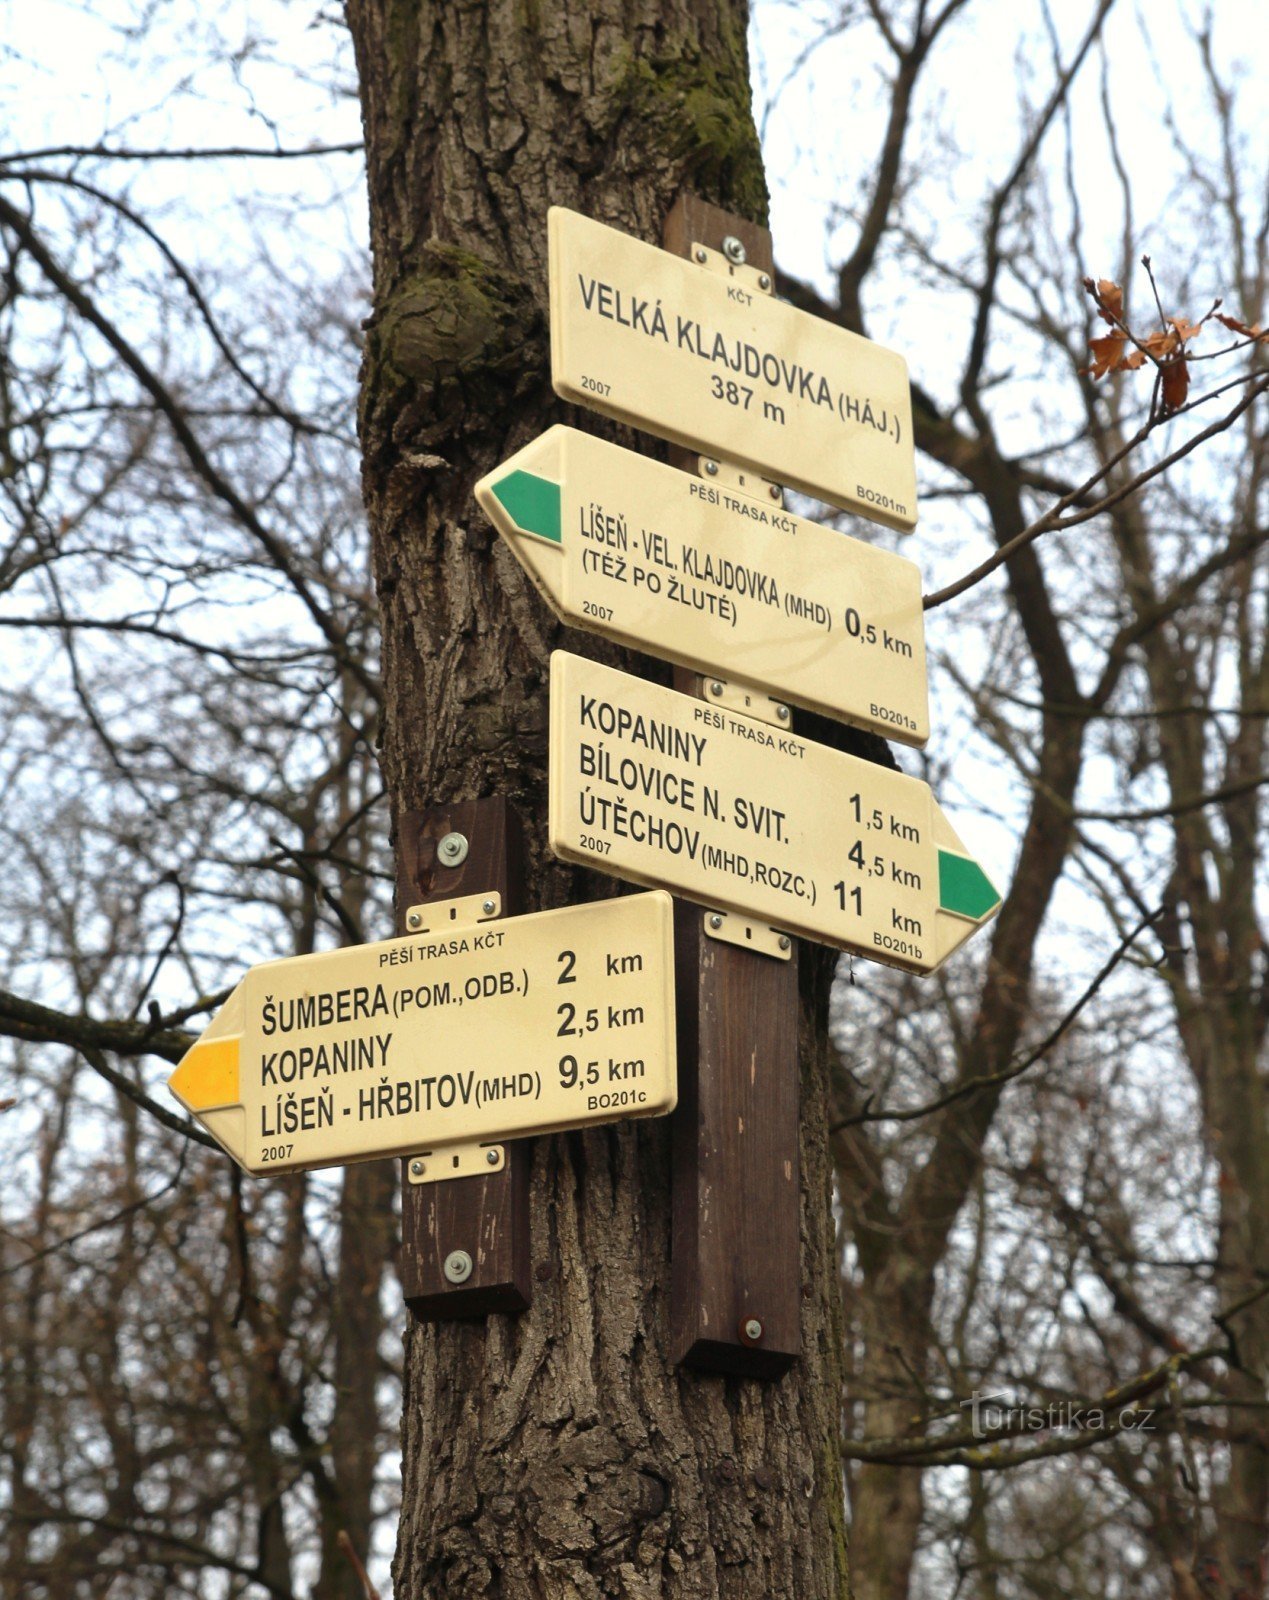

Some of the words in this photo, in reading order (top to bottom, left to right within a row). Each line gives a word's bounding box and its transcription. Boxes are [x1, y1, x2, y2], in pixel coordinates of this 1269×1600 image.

[727, 286, 752, 307] KČT
[578, 273, 669, 343] VELKÁ
[677, 316, 834, 411] KLAJDOVKA
[838, 392, 901, 444] (HÁJ.)
[581, 375, 611, 397] 2007
[711, 374, 754, 411] 387
[763, 400, 786, 425] m
[689, 483, 720, 506] PĚŠÍ
[724, 496, 769, 525] TRASA
[771, 510, 798, 536] KČT
[856, 485, 907, 515] BO201m
[580, 502, 628, 553] LÍŠEŇ
[642, 529, 678, 570] VEL.
[682, 544, 780, 609] KLAJDOVKA
[784, 592, 832, 632] (MHD)
[845, 607, 877, 645] 0,5
[883, 629, 913, 659] km
[582, 548, 627, 583] (TÉŽ
[633, 567, 661, 594] PO
[667, 574, 738, 627] ŽLUTÉ)
[583, 601, 614, 622] 2007
[694, 708, 725, 731] PĚŠÍ
[729, 720, 775, 748] TRASA
[778, 733, 806, 760] KČT
[870, 703, 917, 731] BO201a
[580, 694, 707, 767] KOPANINY
[849, 793, 883, 831] 1,5
[890, 815, 921, 844] km
[580, 741, 695, 812] BÍLOVICE
[703, 785, 726, 824] N.
[734, 797, 790, 845] SVIT.
[847, 839, 884, 877] 4,5
[891, 861, 921, 890] km
[580, 834, 611, 856] 2007
[833, 881, 863, 917] 11
[891, 908, 922, 937] km
[379, 947, 414, 968] PĚŠÍ
[417, 940, 470, 962] TRASA
[473, 931, 506, 951] KČT
[874, 932, 923, 960] BO201b
[261, 983, 389, 1036] ŠUMBERA
[556, 950, 577, 985] 2
[606, 953, 643, 977] km
[261, 1033, 393, 1087] KOPANINY
[556, 1002, 599, 1038] 2,5
[607, 1006, 644, 1029] km
[261, 1086, 334, 1138] LÍŠEŇ
[558, 1055, 600, 1090] 9,5
[608, 1058, 645, 1082] km
[587, 1090, 647, 1111] BO201c
[261, 1144, 294, 1162] 2007
